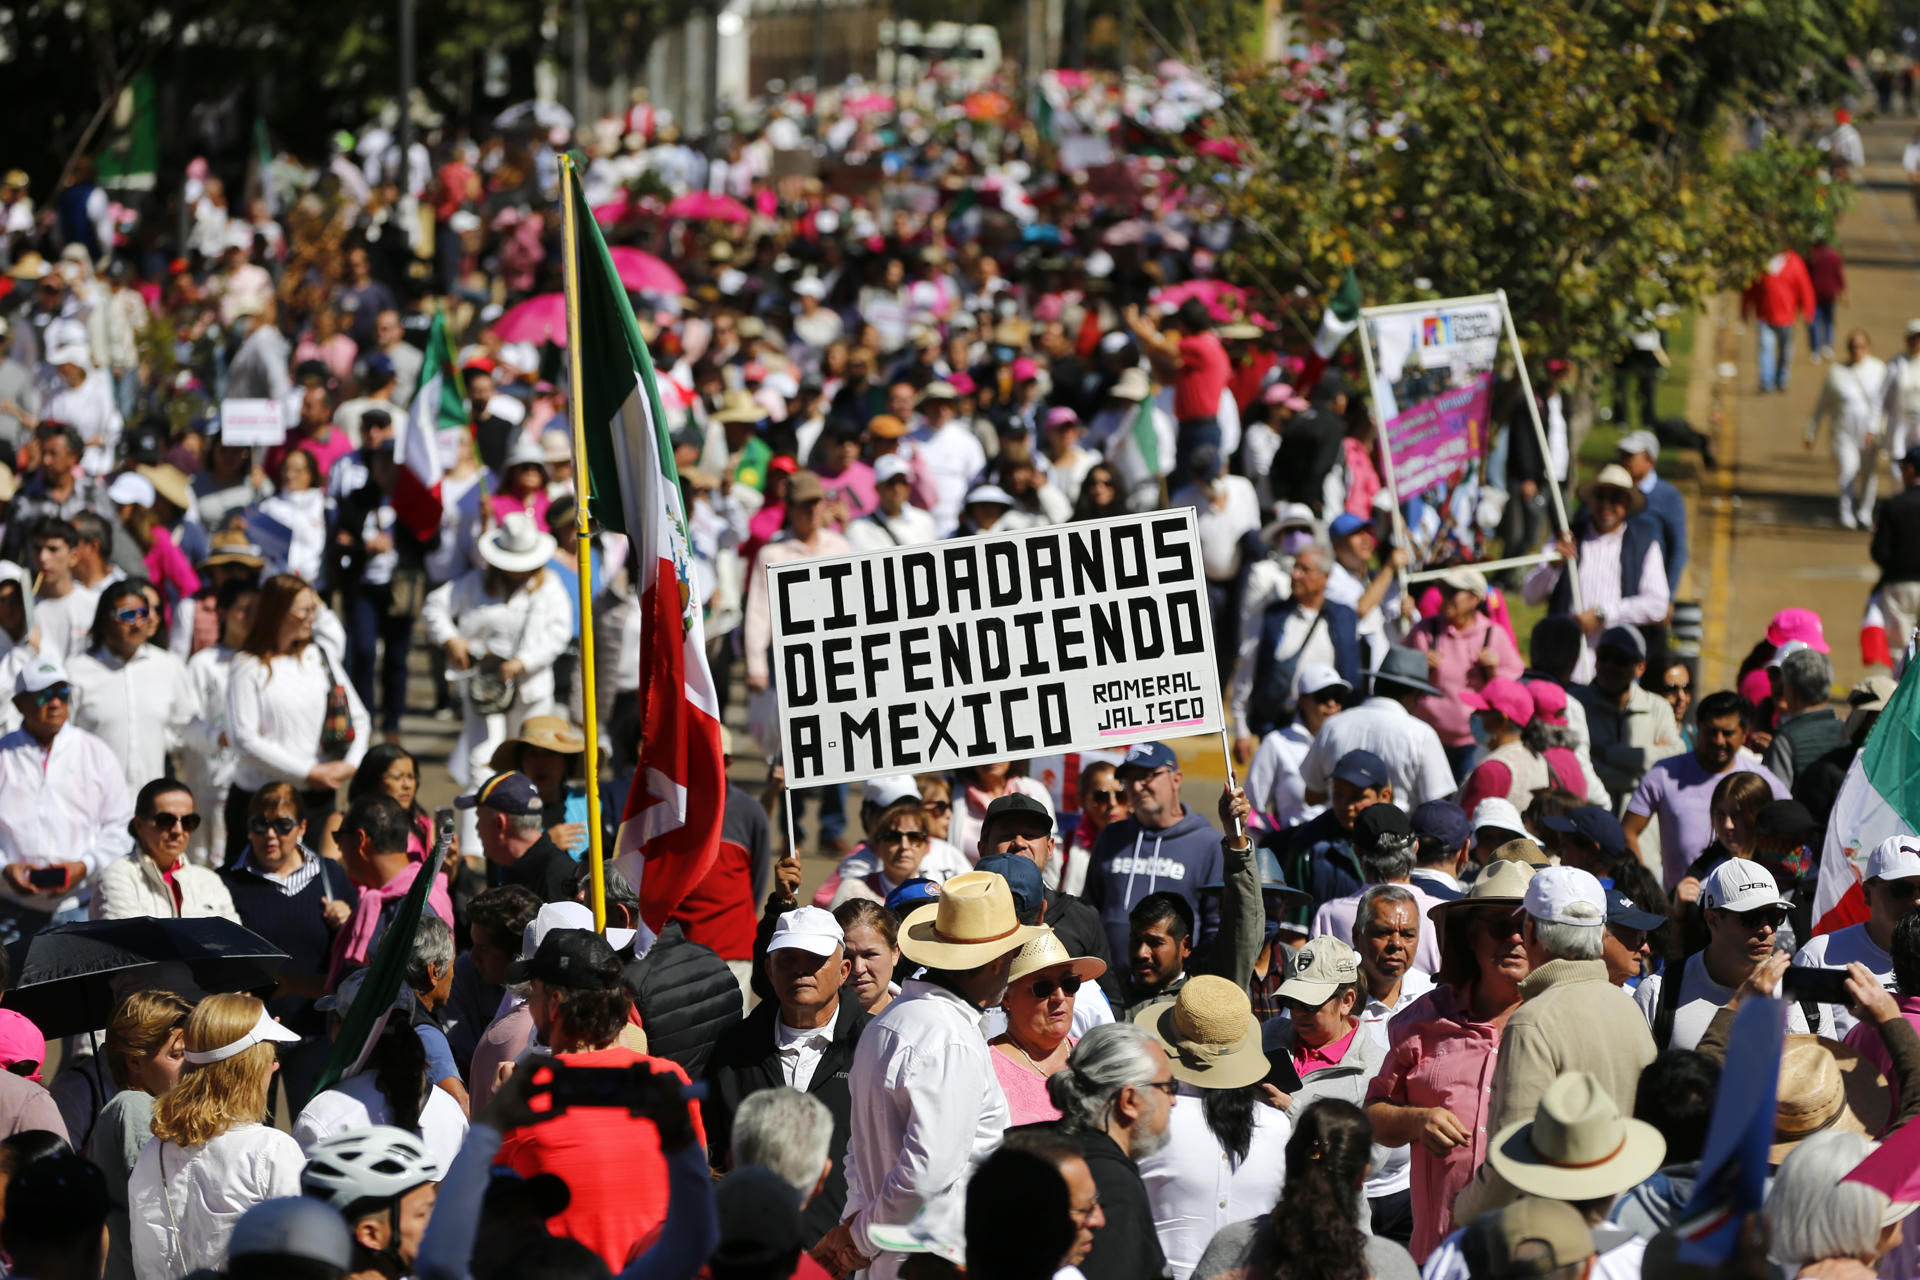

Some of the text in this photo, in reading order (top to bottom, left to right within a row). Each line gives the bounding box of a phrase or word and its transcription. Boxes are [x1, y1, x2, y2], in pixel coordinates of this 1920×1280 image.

[777, 517, 1194, 635] CIUDADANOS
[783, 589, 1204, 707] DEFENDIENDO
[1093, 671, 1200, 704] ROMERAL
[840, 682, 1072, 772] MEXICO
[1098, 697, 1204, 730] JALISCO
